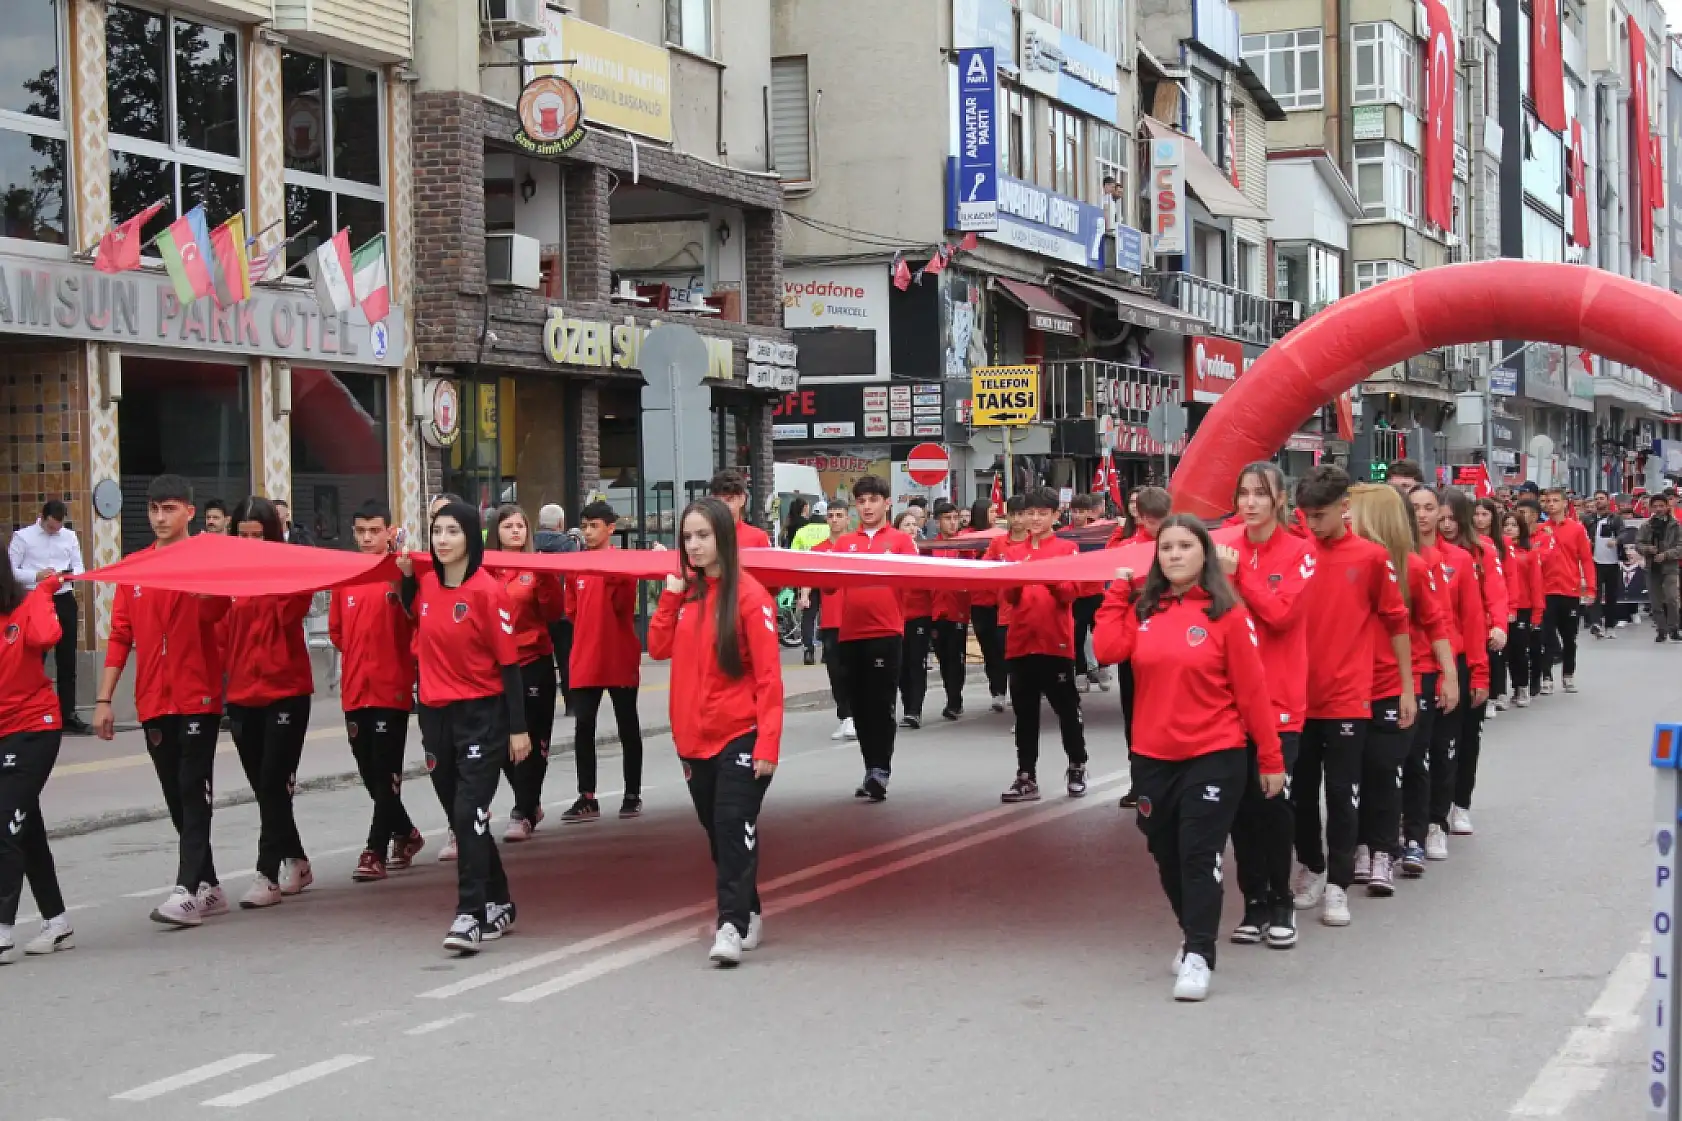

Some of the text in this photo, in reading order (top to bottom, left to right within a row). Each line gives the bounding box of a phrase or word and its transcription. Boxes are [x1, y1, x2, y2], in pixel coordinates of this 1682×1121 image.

[967, 53, 987, 76] A
[965, 97, 977, 158] ANAHTAR
[784, 280, 865, 298] vodafone
[157, 287, 261, 347] PARK
[272, 304, 359, 356] OTEL
[544, 306, 612, 367] ÖZEN
[975, 391, 1034, 410] TAKSİ
[980, 379, 1029, 390] TELEFON
[1651, 865, 1670, 1074] POLİS
